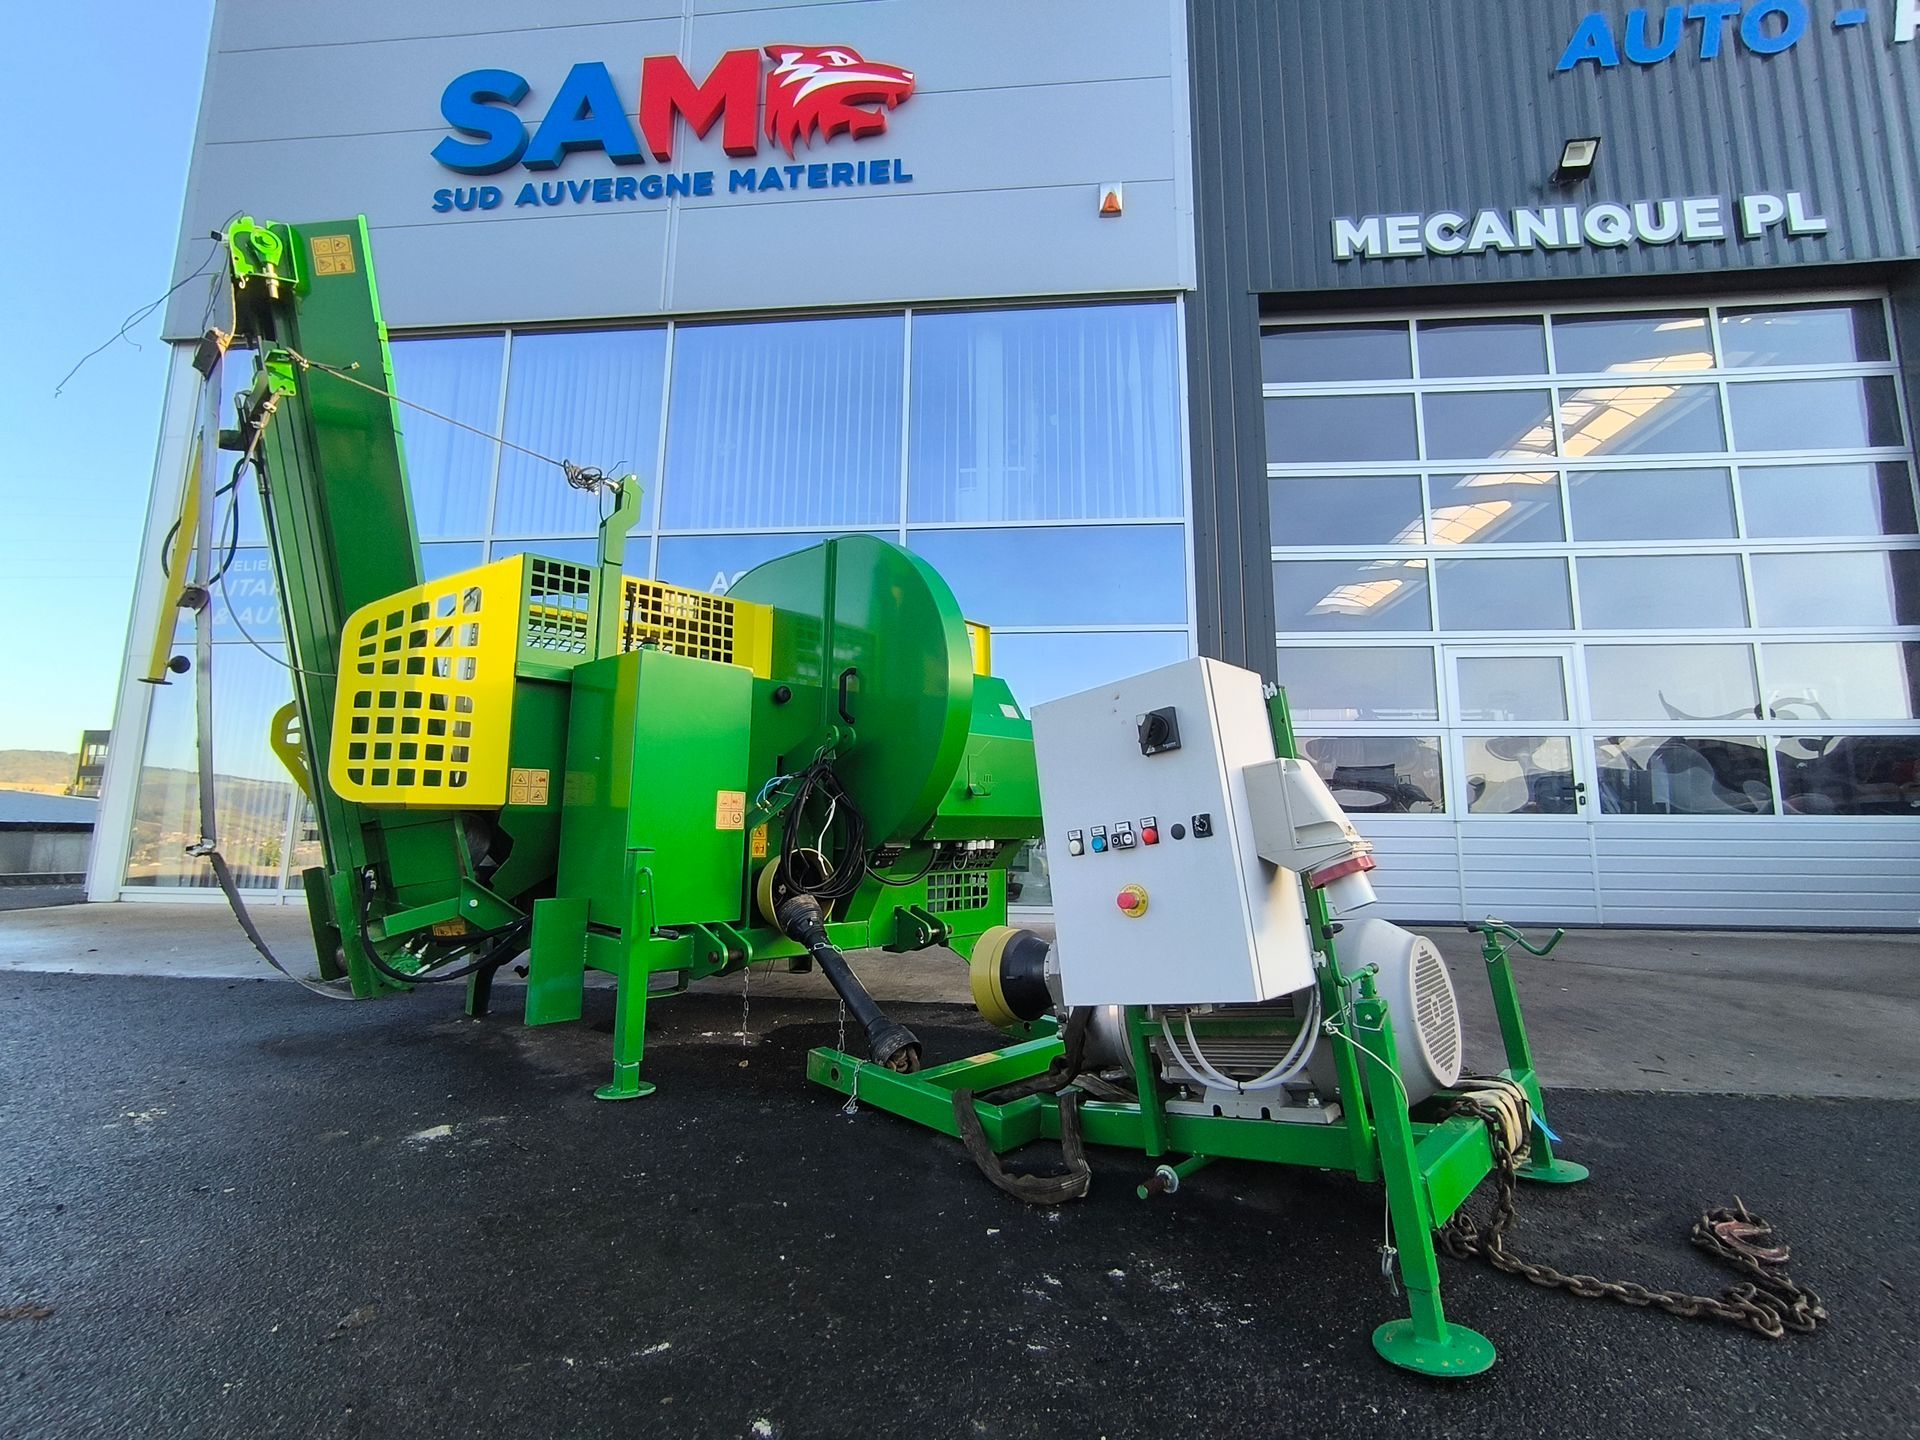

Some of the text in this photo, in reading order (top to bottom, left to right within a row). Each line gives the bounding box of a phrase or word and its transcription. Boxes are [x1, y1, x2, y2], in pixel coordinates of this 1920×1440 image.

[1555, 0, 1808, 71] AUTO
[430, 48, 762, 176] SAM
[431, 159, 914, 213] SUD AUVERGNE MATERIEL
[1332, 191, 1828, 260] MECANIQUE PL
